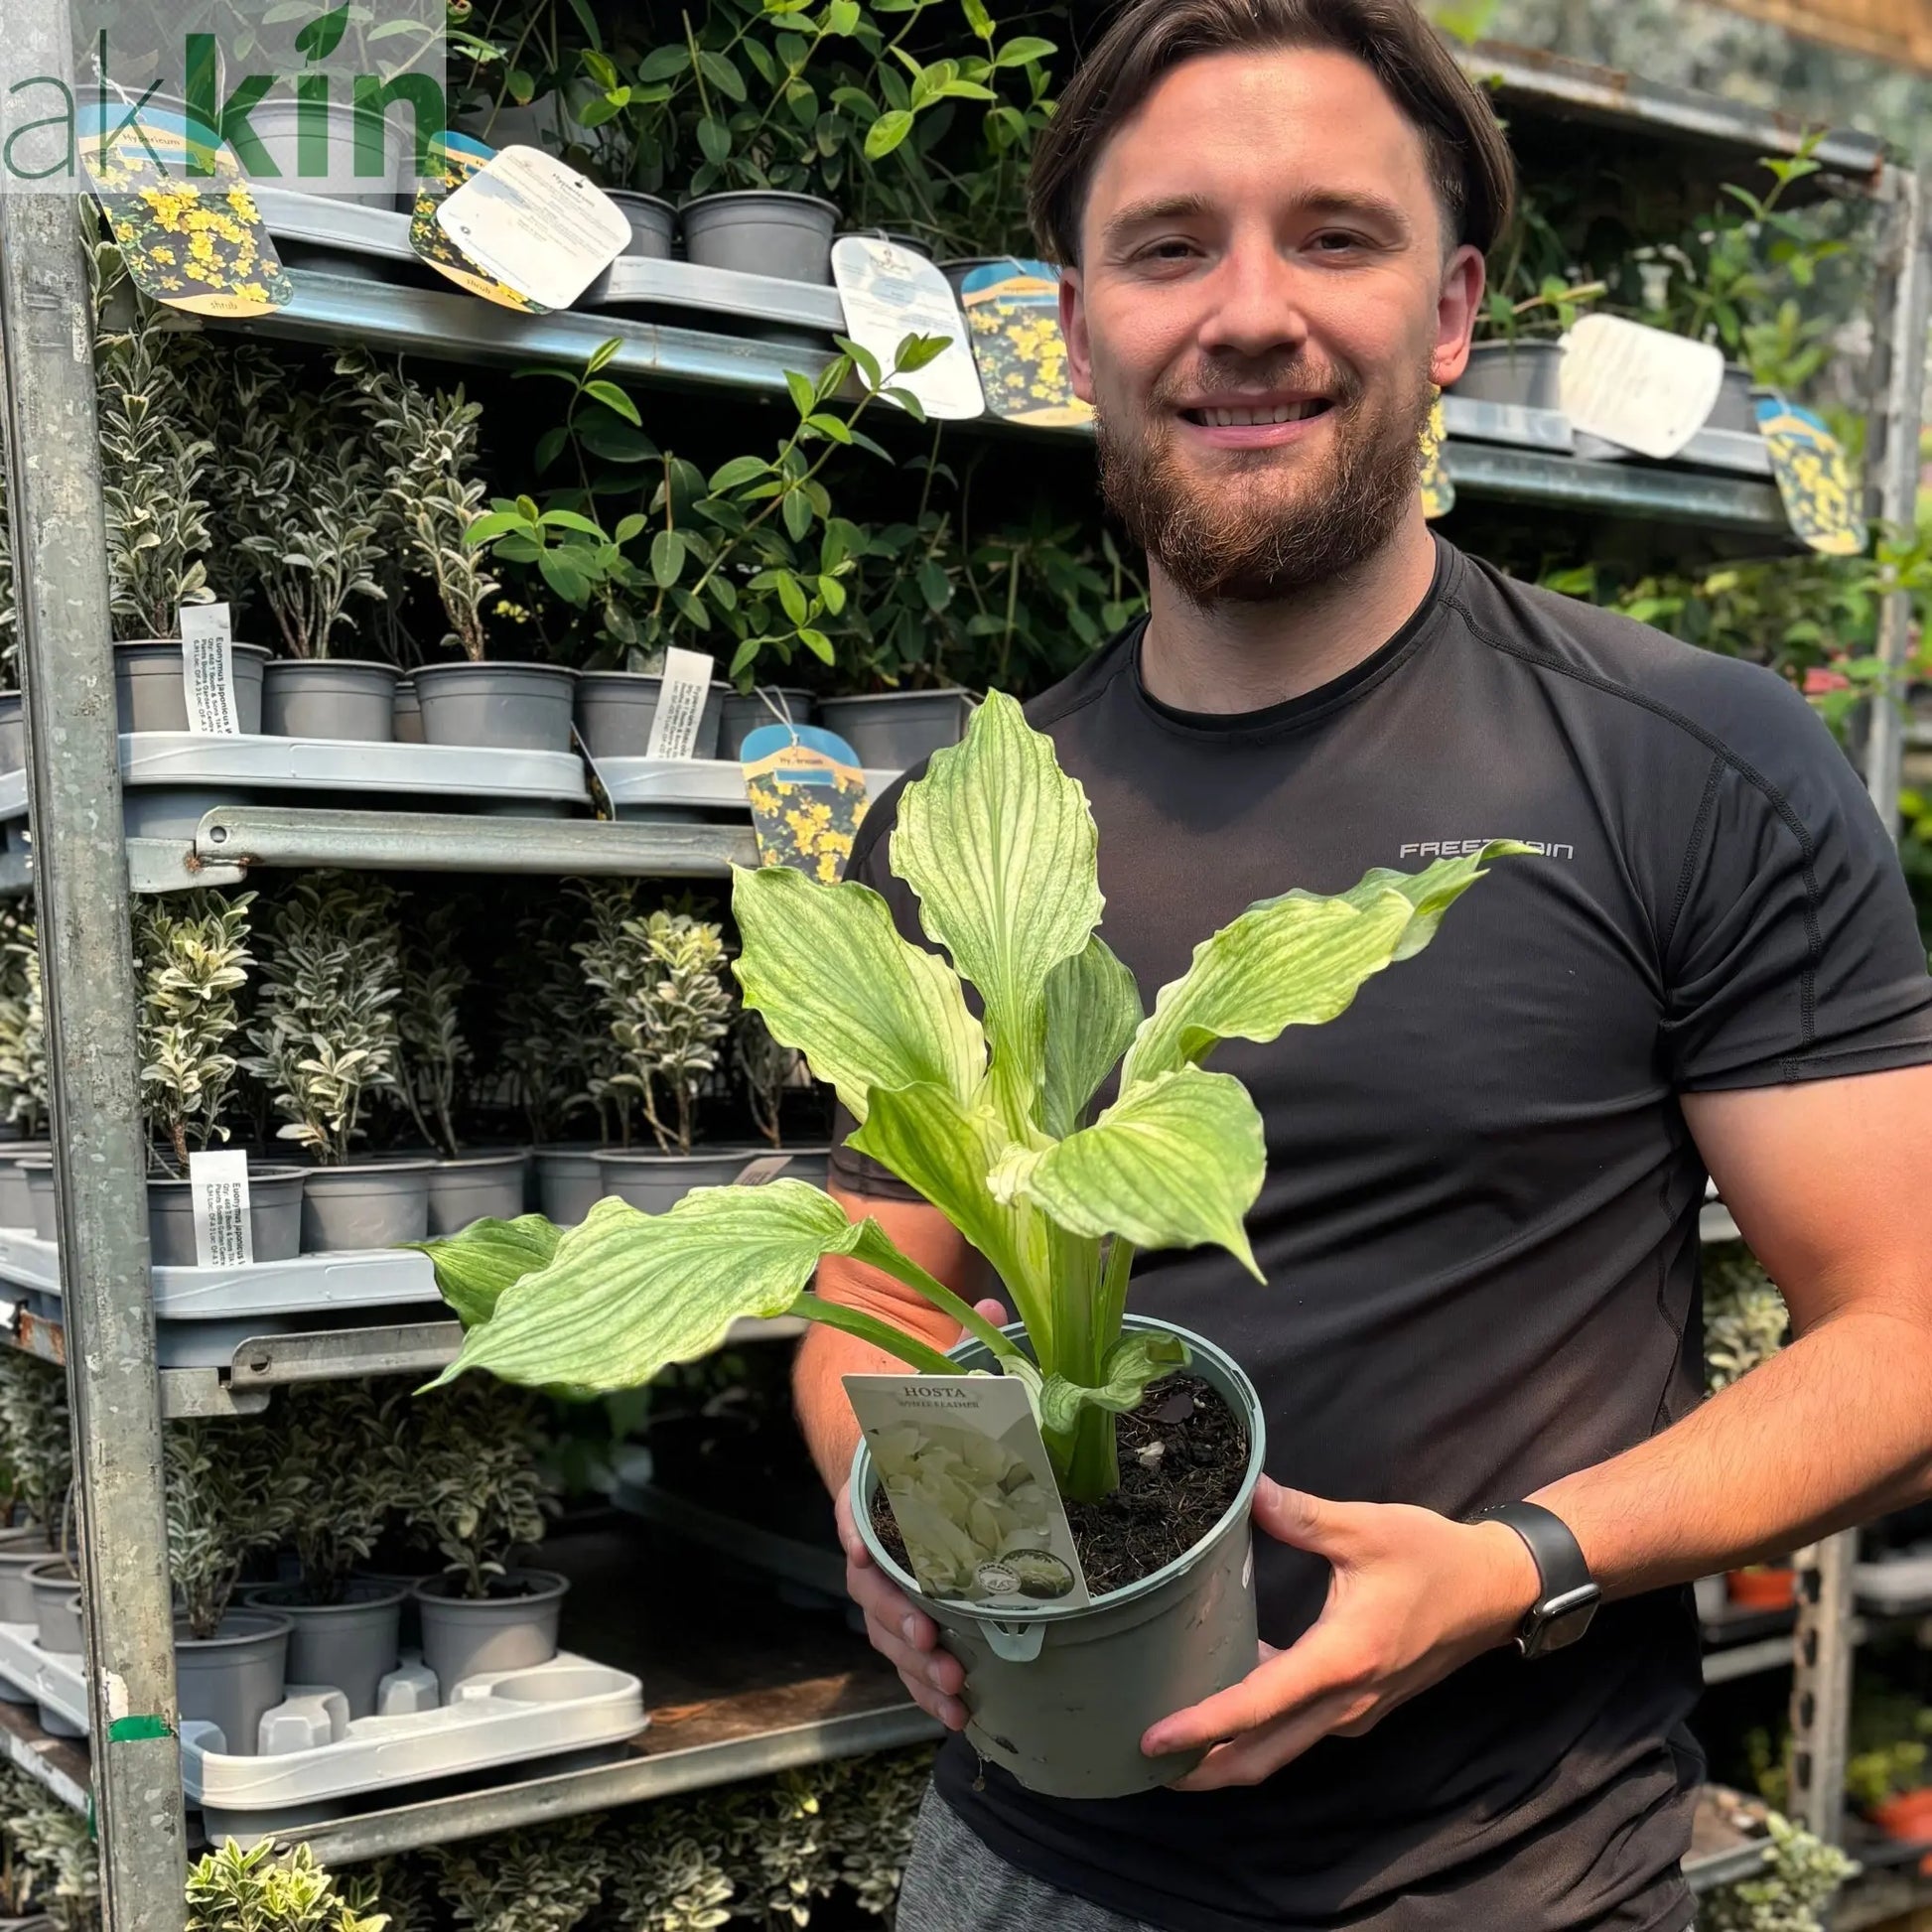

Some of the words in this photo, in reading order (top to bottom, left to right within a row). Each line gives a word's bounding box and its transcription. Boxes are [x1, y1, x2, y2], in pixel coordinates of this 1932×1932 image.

[215, 636, 224, 682] Euonymus
[216, 683, 229, 726] japonicus
[1399, 839, 1574, 860] FREEAIN
[232, 1182, 241, 1223] Euonymus
[233, 1225, 244, 1259] japonicus
[903, 1386, 966, 1398] HOSTA
